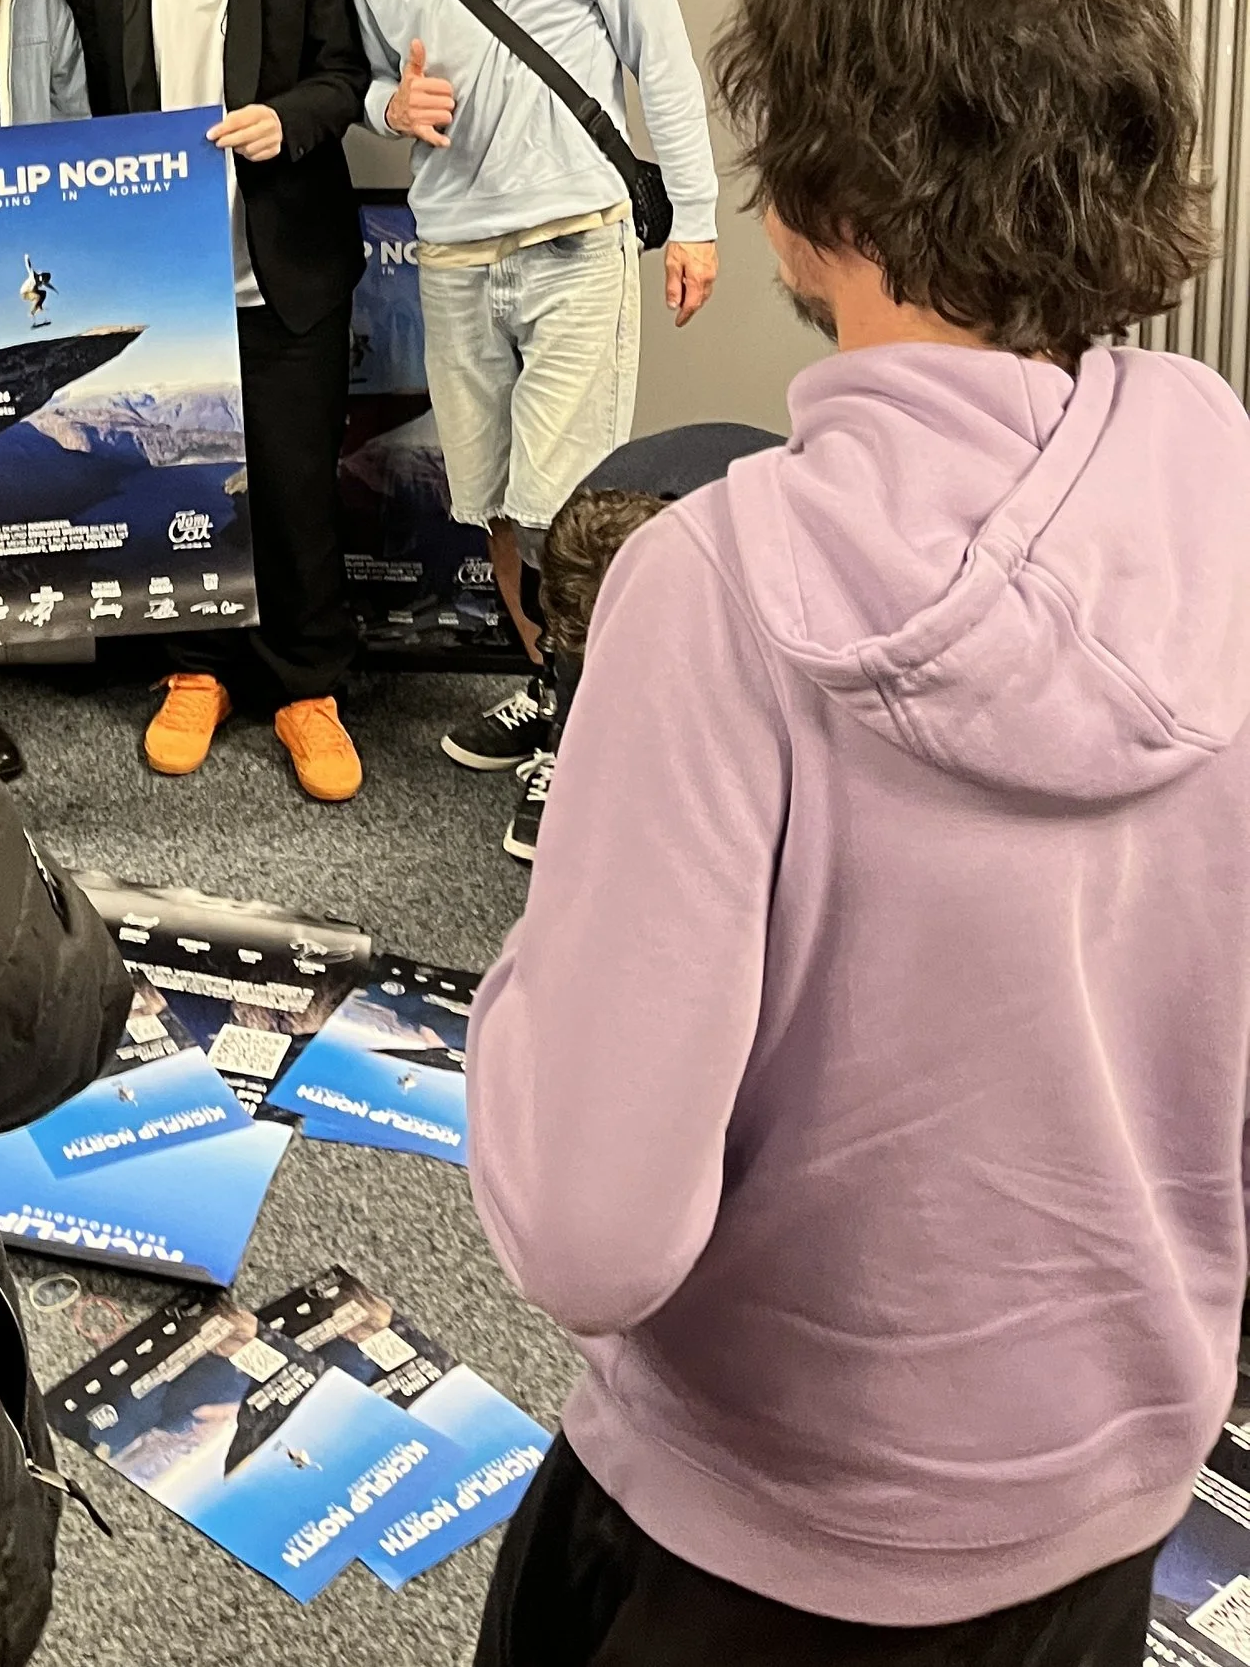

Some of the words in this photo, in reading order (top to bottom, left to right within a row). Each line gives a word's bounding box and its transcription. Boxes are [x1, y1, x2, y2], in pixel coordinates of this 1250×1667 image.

[59, 151, 188, 189] NORTH
[63, 191, 78, 202] IN
[109, 182, 171, 197] NORWAY
[62, 1128, 137, 1160] NORTH
[138, 1106, 227, 1140] KICKFLIP
[350, 1439, 430, 1514] KICKFLIP
[456, 1445, 545, 1511] KICKFLIP
[281, 1503, 355, 1568] NORTH
[378, 1497, 460, 1557] NORTH
